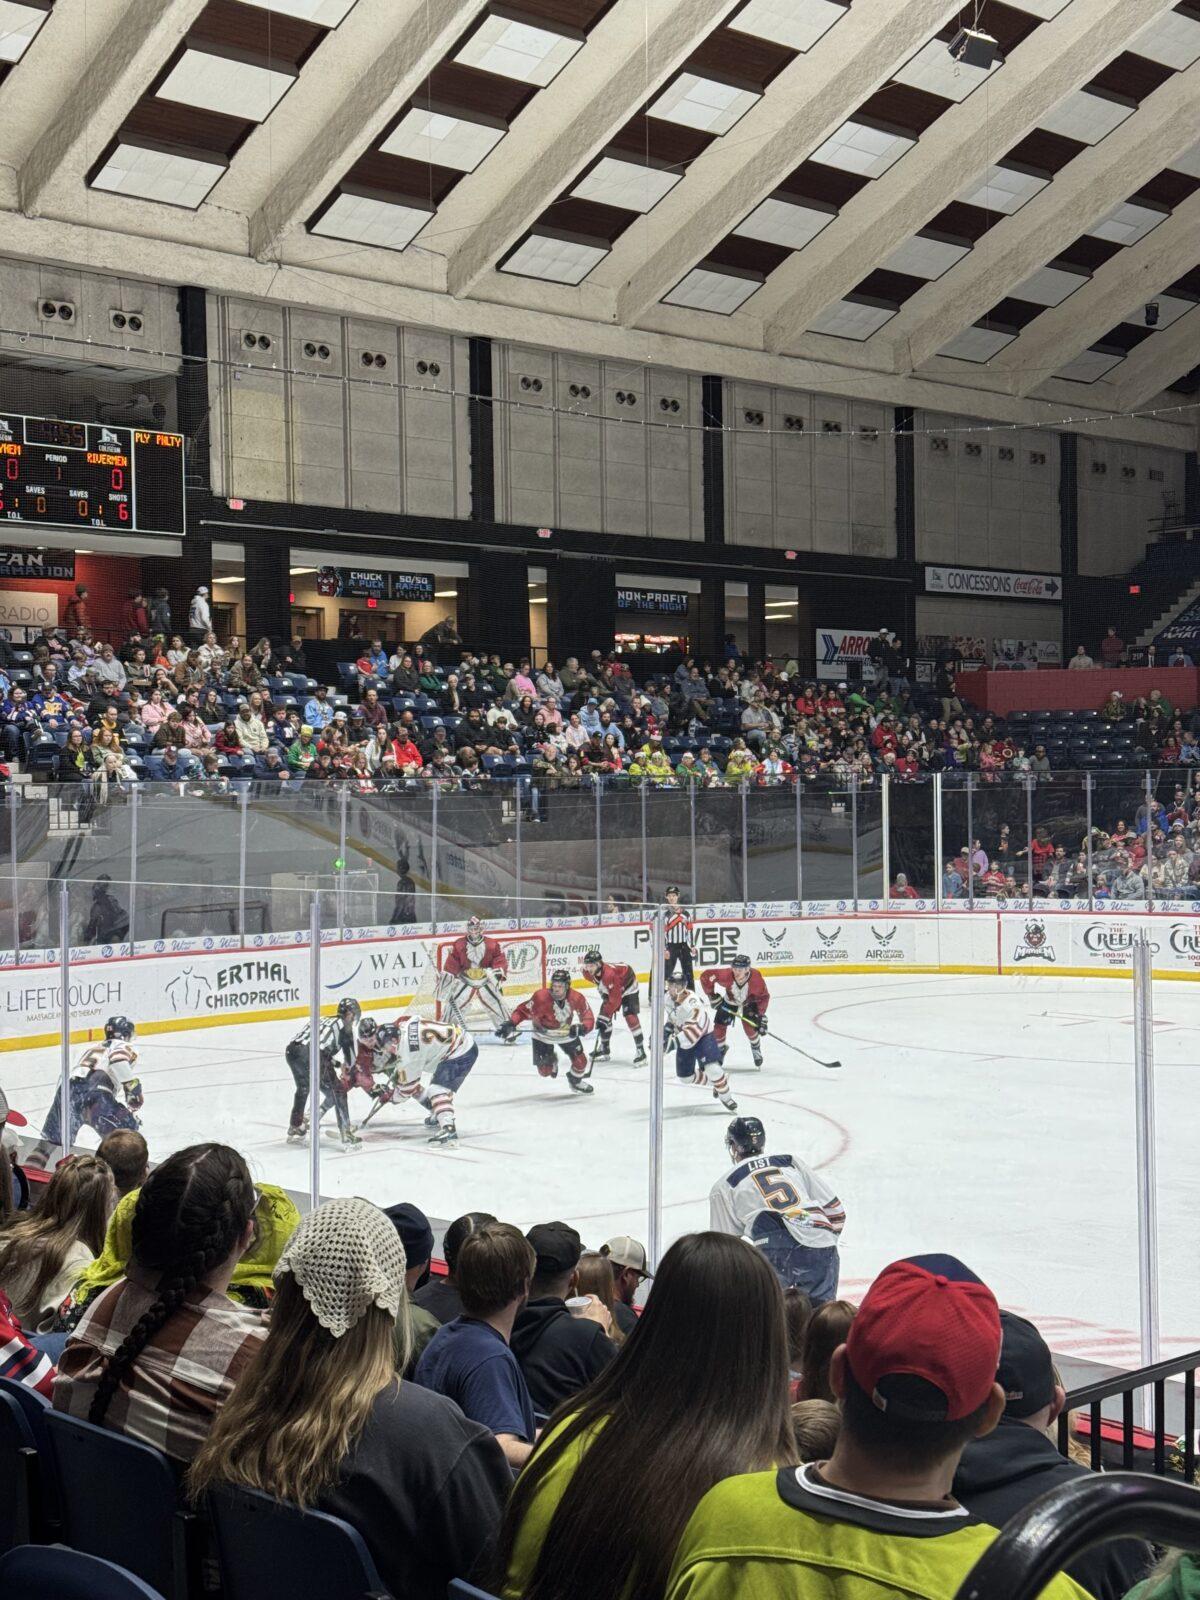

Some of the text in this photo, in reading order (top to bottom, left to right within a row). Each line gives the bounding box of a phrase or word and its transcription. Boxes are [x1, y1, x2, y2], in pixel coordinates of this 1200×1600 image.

[135, 432, 150, 444] PLY
[45, 453, 68, 463] PERIOD
[86, 453, 128, 467] RIVERMEN
[7, 458, 19, 480] 0
[111, 468, 123, 490] 0
[25, 485, 46, 494] SAVES
[68, 489, 89, 499] SAVES
[108, 493, 128, 502] SHOTS
[37, 496, 46, 513] 0
[78, 499, 88, 517] 0
[118, 502, 129, 521] 6
[350, 572, 382, 581] CHUCK
[400, 575, 428, 585] 50/50
[948, 572, 1011, 593] CONCESSIONS
[359, 580, 385, 589] PUCK
[395, 582, 432, 592] RAFFLE
[617, 591, 688, 604] NON-PROFIT
[617, 600, 687, 611] OF THE NIGHT
[0, 605, 49, 622] RADIO
[839, 634, 871, 656] ARRO
[756, 951, 774, 961] AIR
[809, 950, 828, 960] AIR
[865, 949, 883, 959] AIR
[545, 956, 568, 967] ress
[217, 960, 292, 992] ERTHAL
[7, 981, 122, 1013] LIFETOUCH
[205, 987, 300, 1010] CHIROPRACTIC
[748, 1157, 771, 1172] LIST
[751, 1167, 801, 1214] 5
